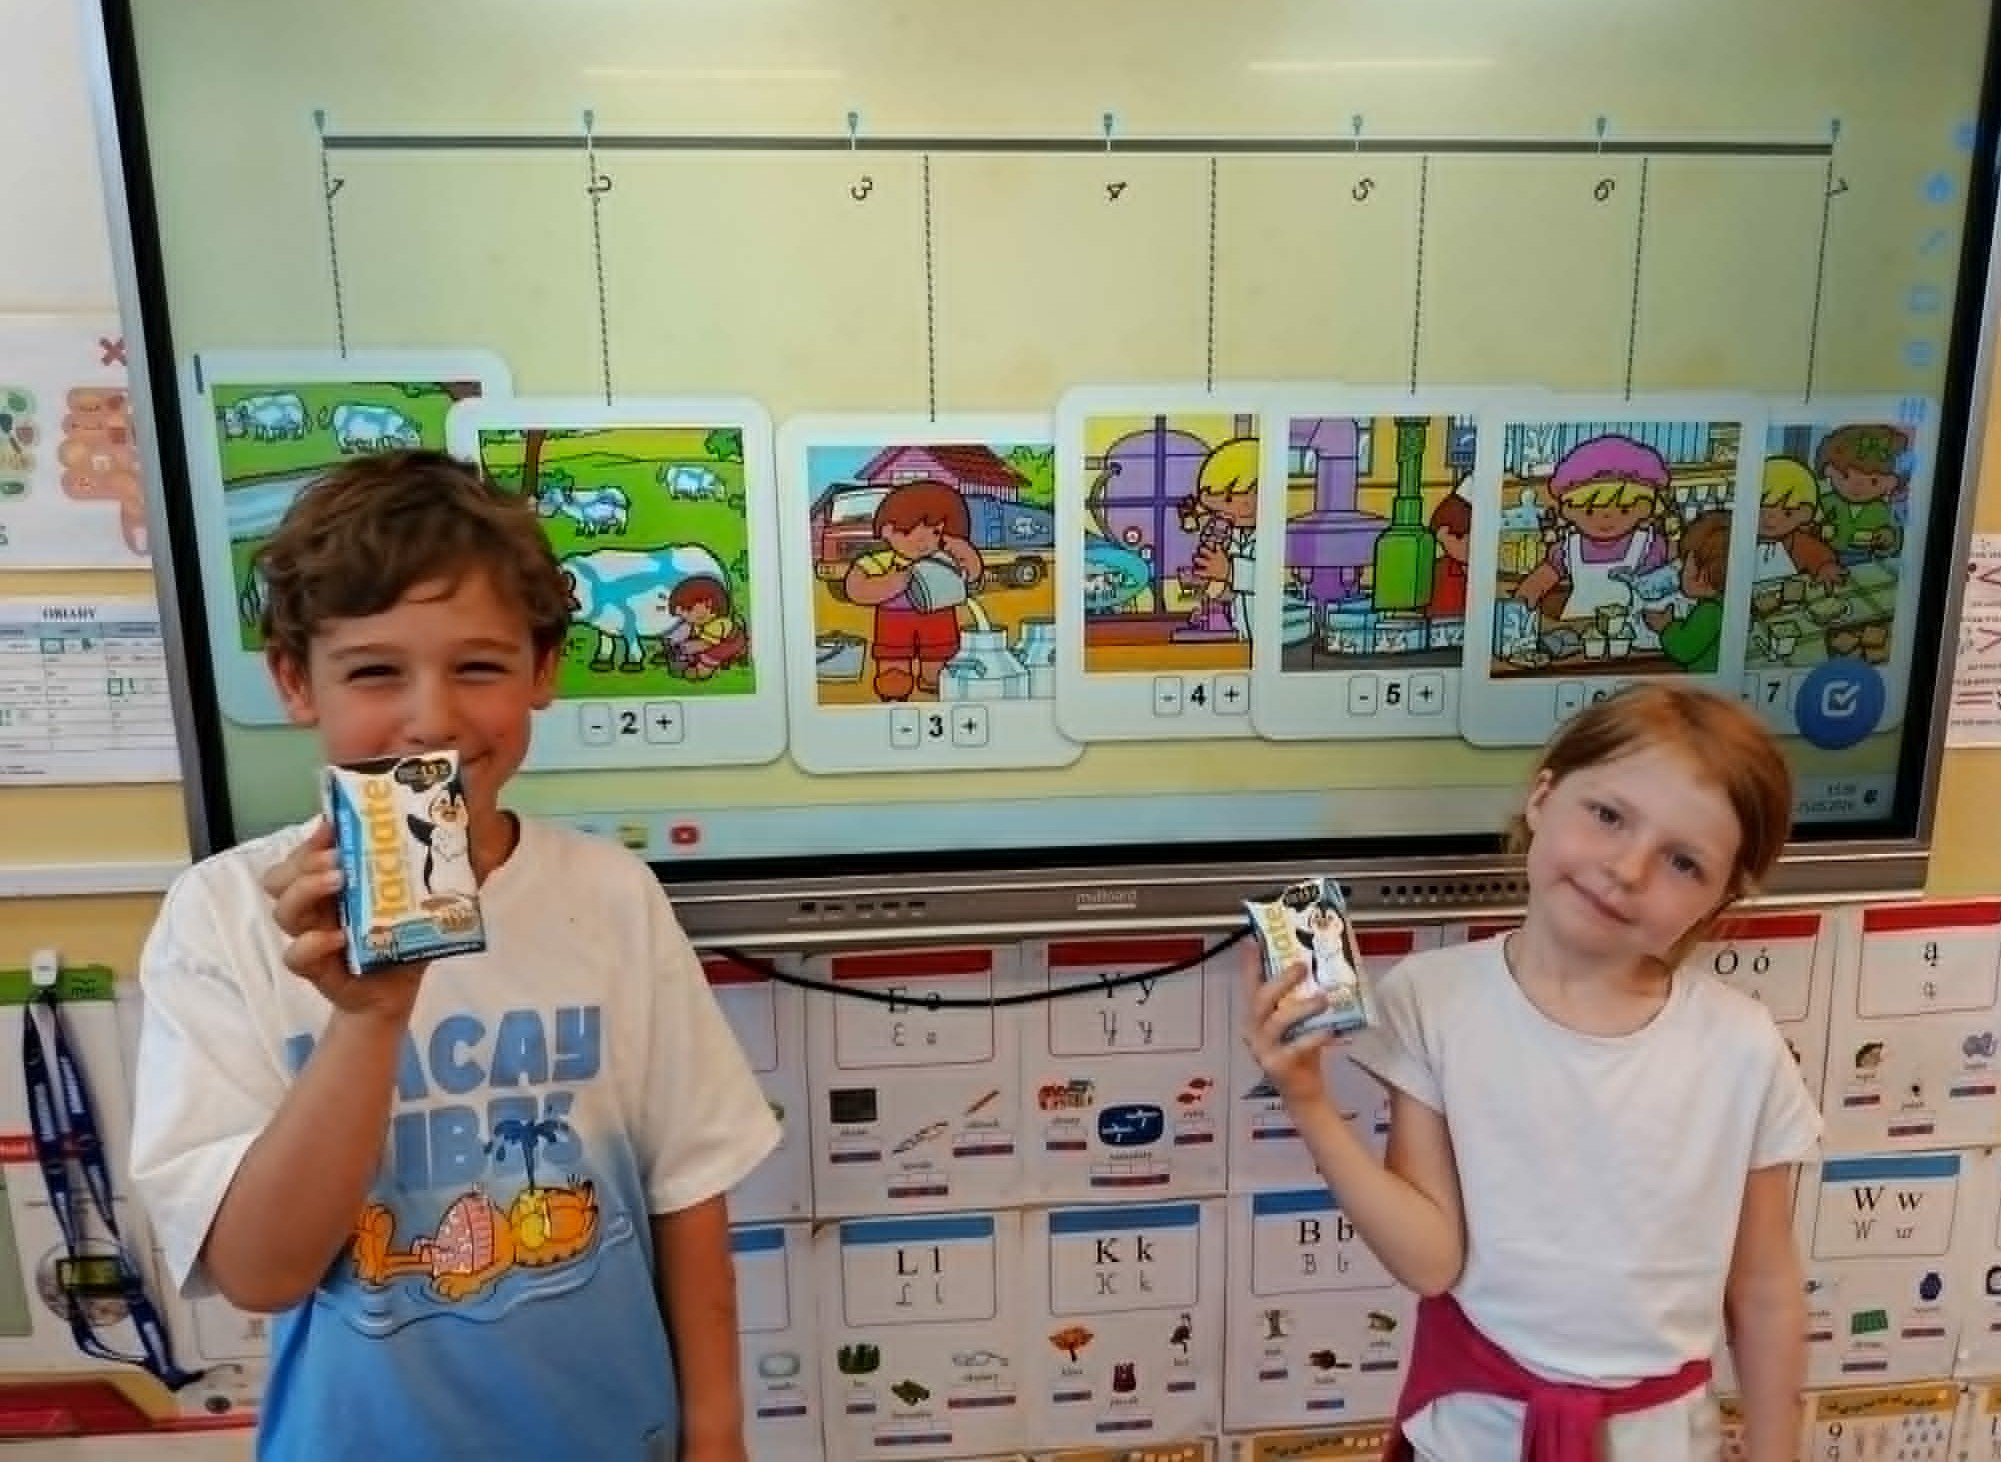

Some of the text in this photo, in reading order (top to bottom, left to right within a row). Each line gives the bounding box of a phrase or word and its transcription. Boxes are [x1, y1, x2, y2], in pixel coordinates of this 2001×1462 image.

[851, 175, 873, 200] 3
[1104, 181, 1127, 200] 4
[1352, 177, 1374, 202] 5
[1593, 177, 1615, 202] 6
[1190, 685, 1206, 706] 4
[1386, 685, 1400, 705] 5
[1766, 683, 1780, 703] 7
[620, 712, 639, 735] 2
[928, 716, 944, 738] 3
[1753, 946, 1769, 974] ó
[1137, 979, 1154, 1005] y
[285, 1005, 600, 1101] ACAY
[393, 1091, 583, 1194] IBES
[1851, 1186, 1922, 1211] W w
[1299, 1216, 1353, 1244] B b
[1854, 1219, 1875, 1239] W
[898, 1250, 917, 1275] L
[1096, 1236, 1152, 1264] K k
[1304, 1253, 1317, 1274] B
